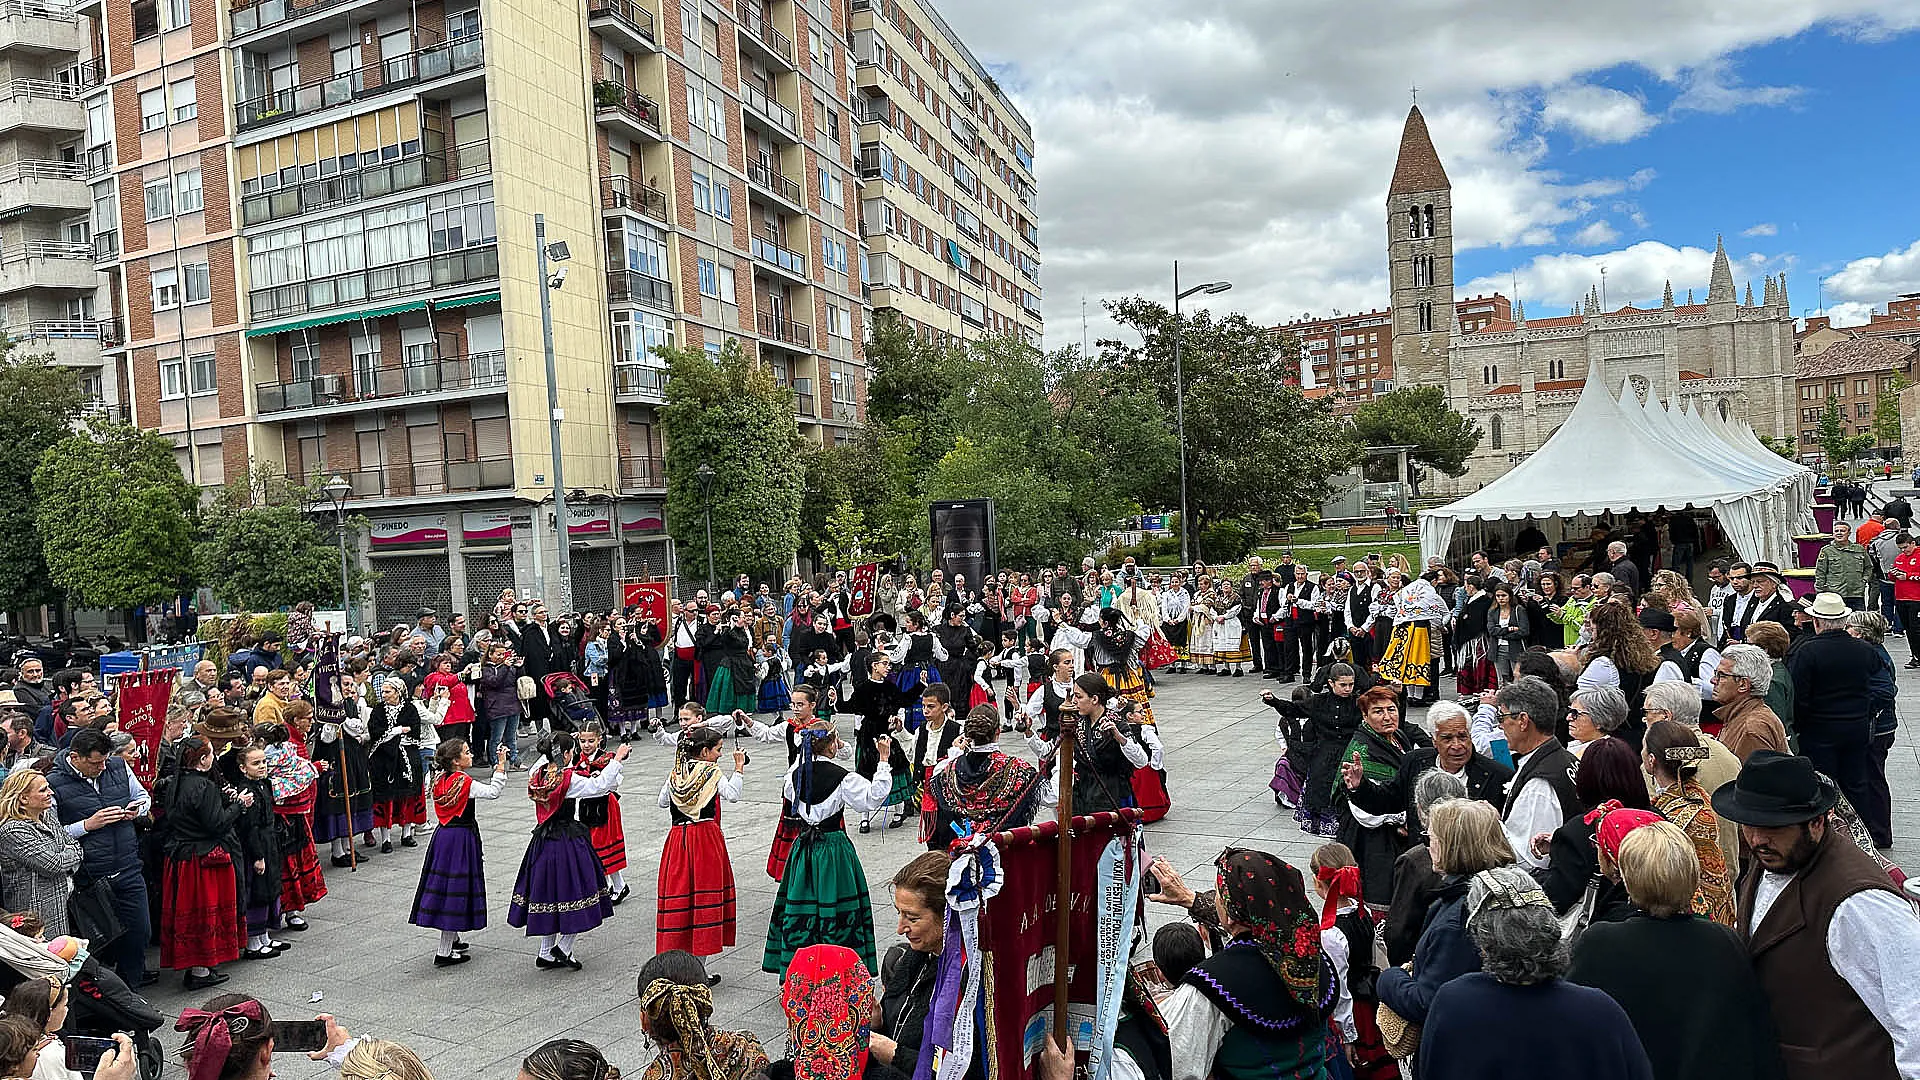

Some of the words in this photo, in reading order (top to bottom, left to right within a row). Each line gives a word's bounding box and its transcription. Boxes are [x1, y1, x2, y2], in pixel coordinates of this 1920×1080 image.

[381, 522, 409, 531] PINEDO
[943, 550, 981, 559] PERIODISMO
[125, 714, 148, 730] GRUPO
[1112, 882, 1123, 917] FESTIVAL
